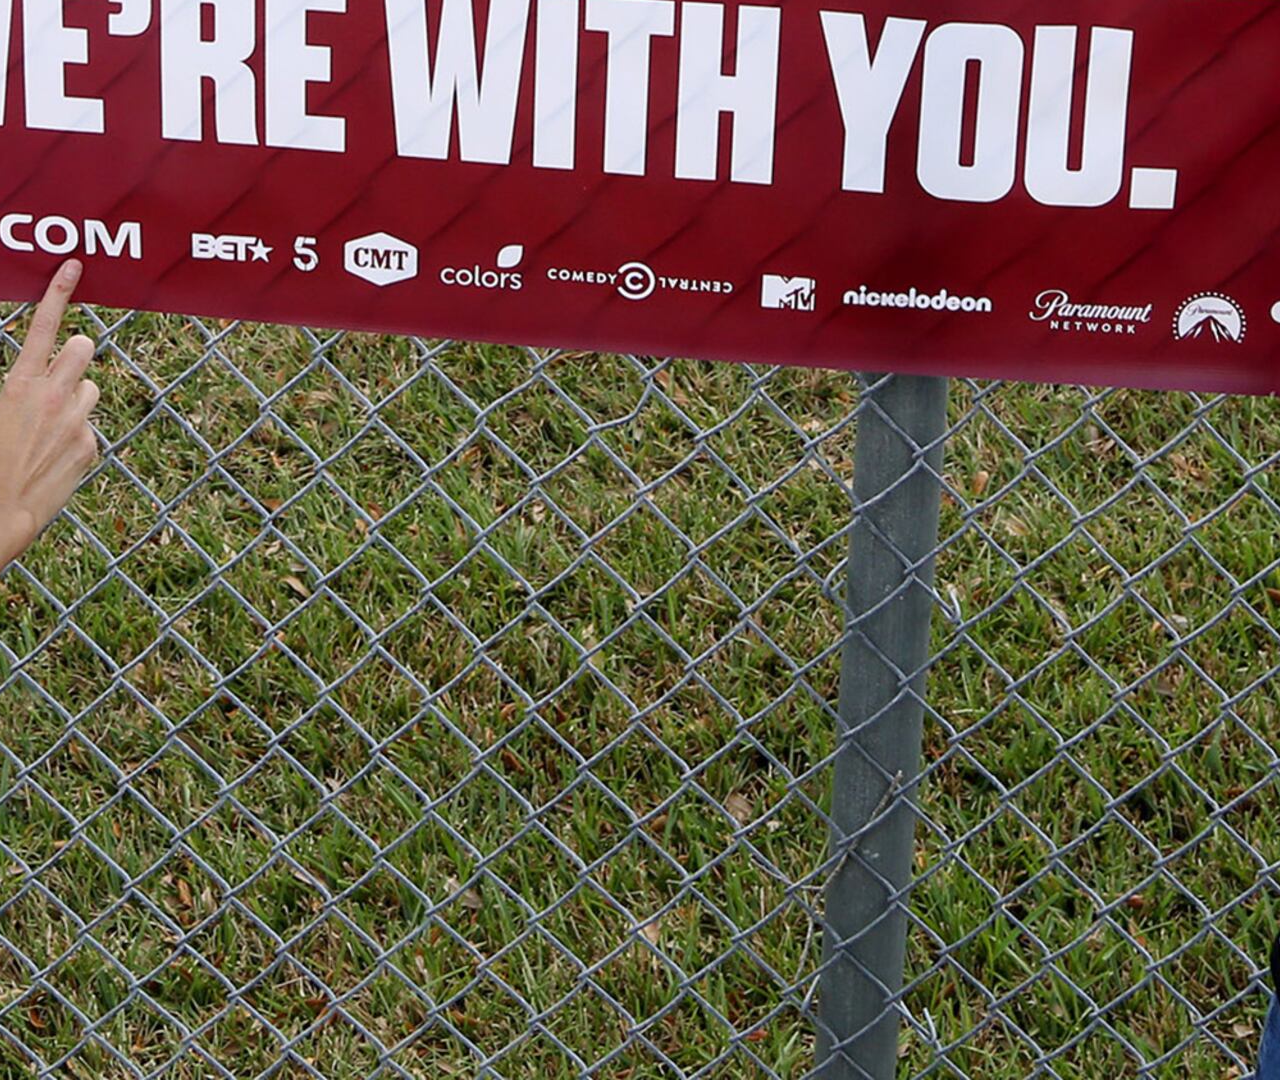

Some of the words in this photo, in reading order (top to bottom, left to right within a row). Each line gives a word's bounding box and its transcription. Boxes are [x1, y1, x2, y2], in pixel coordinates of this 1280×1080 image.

[819, 10, 1178, 210] YOU.
[191, 232, 258, 262] BET
[293, 236, 319, 272] 5
[352, 247, 409, 271] CMT
[439, 264, 523, 290] colors
[546, 268, 618, 285] COMEDY
[760, 274, 816, 312] MTV
[843, 285, 992, 313] nickelodeon
[1028, 289, 1153, 323] Paramount
[1049, 320, 1136, 335] NETWORK
